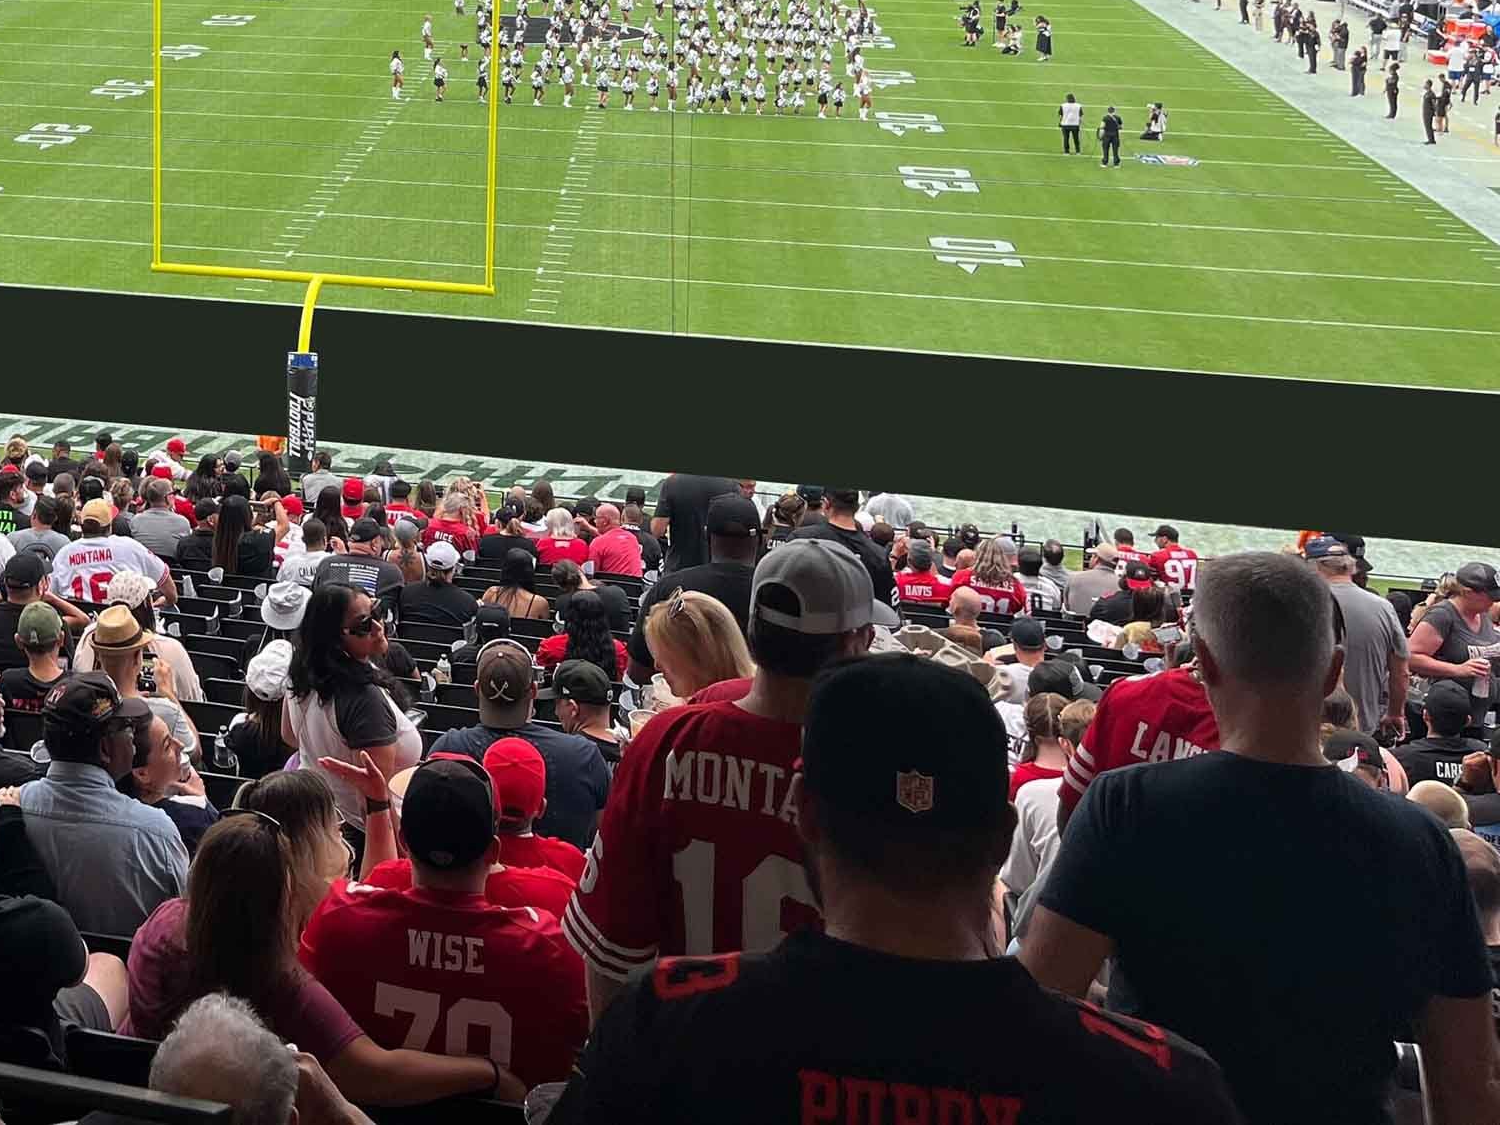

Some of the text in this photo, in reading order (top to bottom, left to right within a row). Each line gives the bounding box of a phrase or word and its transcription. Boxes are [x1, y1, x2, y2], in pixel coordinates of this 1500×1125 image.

[13, 122, 93, 146] 20
[897, 165, 982, 193] 20
[928, 235, 1026, 268] 10
[289, 392, 306, 458] FOOTBALL
[434, 530, 453, 543] RICE
[68, 548, 113, 568] MONTANA
[903, 584, 933, 597] DAVIS
[1164, 559, 1197, 593] 97
[1129, 720, 1210, 765] LAN
[663, 749, 806, 827] MONTA
[407, 928, 486, 975] WISE
